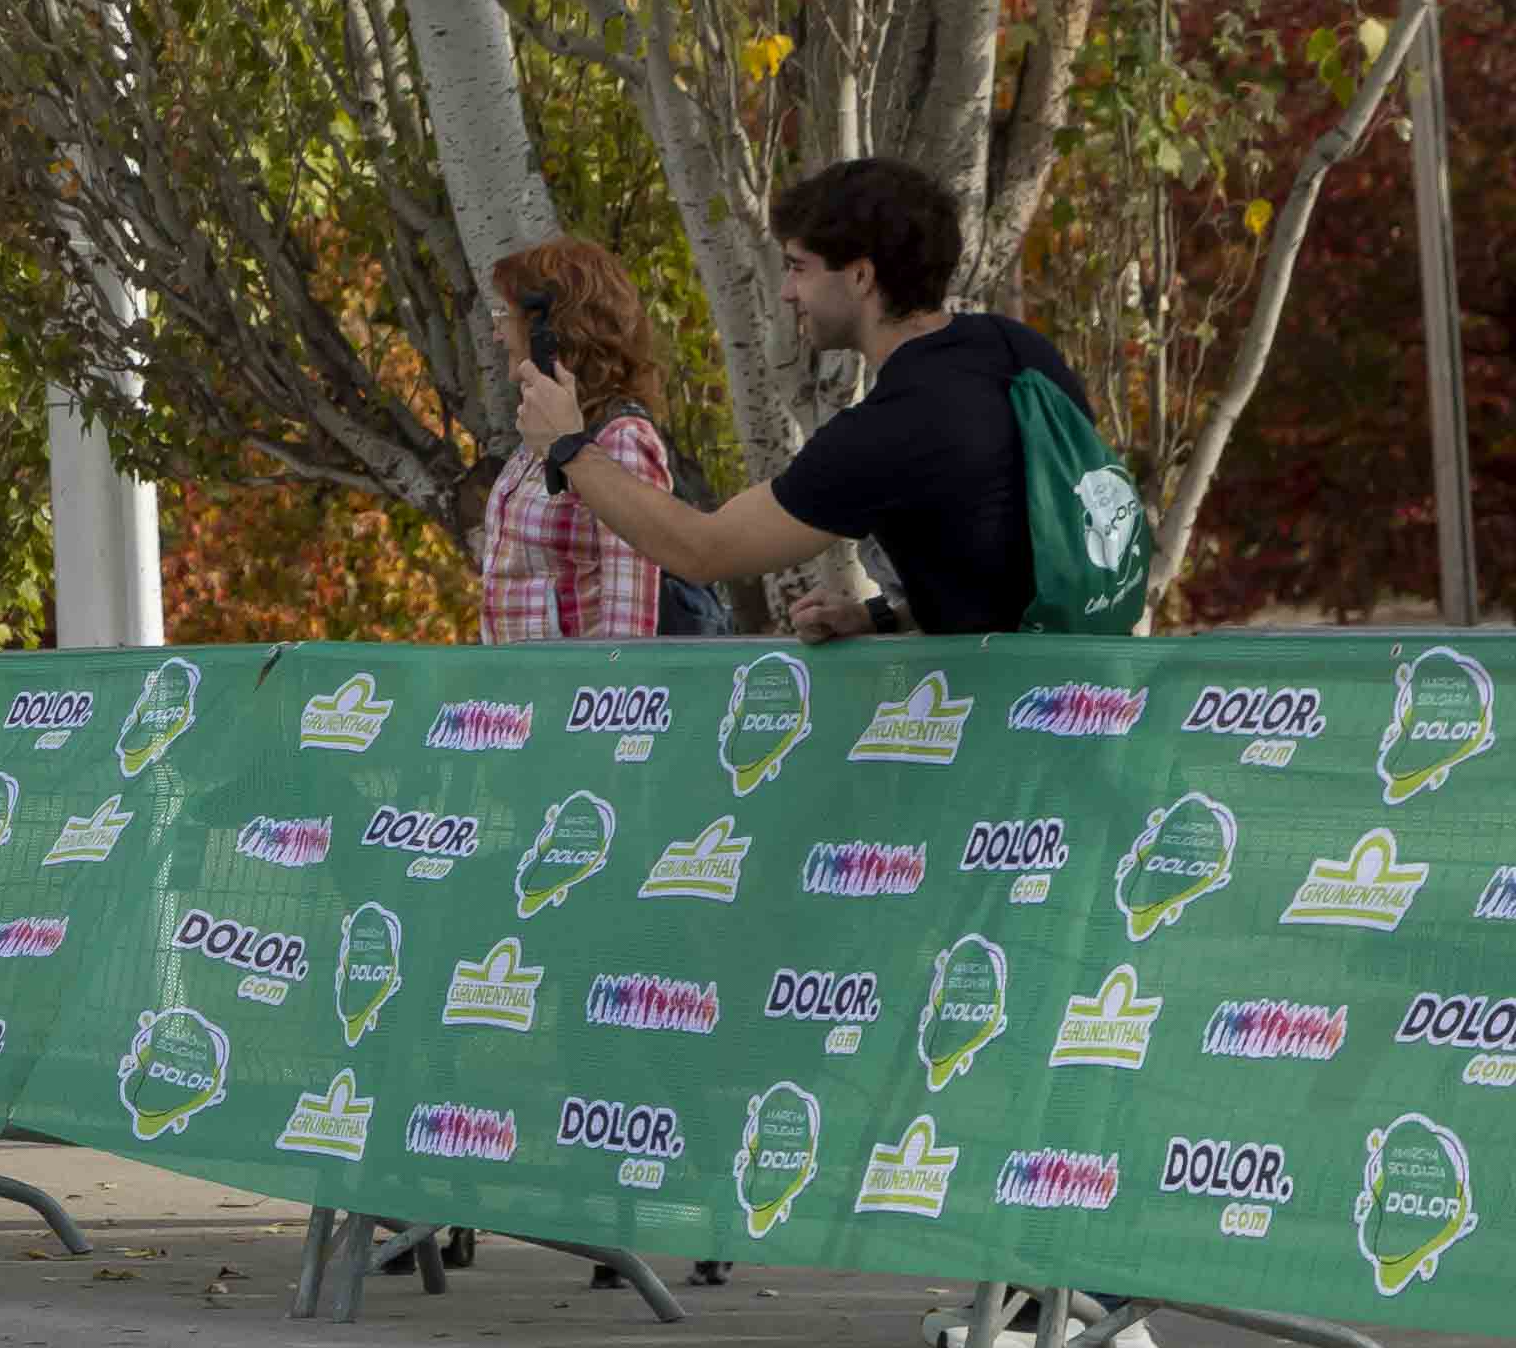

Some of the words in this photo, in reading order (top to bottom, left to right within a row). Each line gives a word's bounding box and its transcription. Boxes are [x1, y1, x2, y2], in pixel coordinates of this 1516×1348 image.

[1410, 720, 1482, 741] DOLOR
[241, 980, 286, 1000] com
[1401, 996, 1516, 1046] DOLO
[1385, 1191, 1463, 1220] DOLOR
[1224, 1208, 1267, 1231] com
